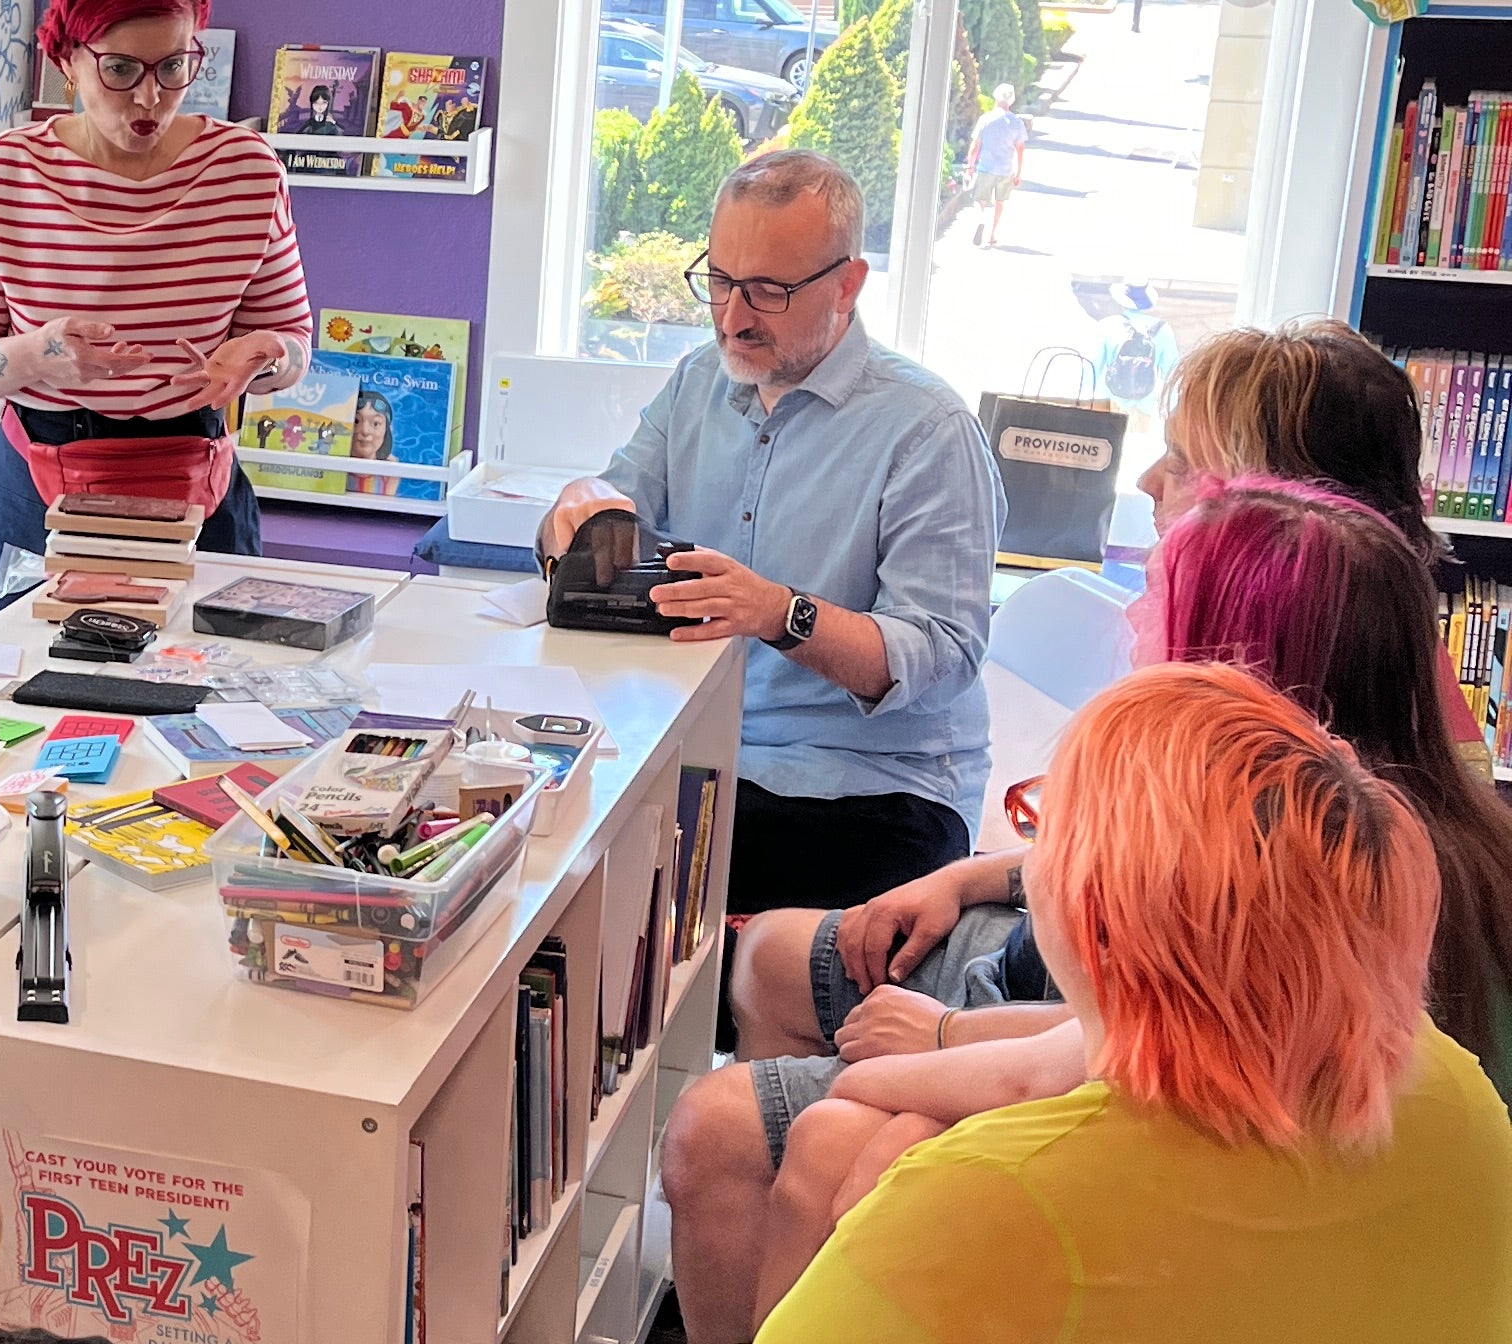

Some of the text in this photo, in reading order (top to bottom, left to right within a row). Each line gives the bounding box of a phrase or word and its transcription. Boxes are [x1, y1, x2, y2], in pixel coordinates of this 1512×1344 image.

[300, 64, 358, 81] WEDNESDAY
[408, 66, 466, 85] SHAZAM!
[293, 155, 305, 168] AM
[307, 154, 346, 169] WEDNESDAY
[394, 162, 429, 174] HEROES
[373, 373, 399, 387] Can
[403, 374, 438, 391] Swim
[1014, 435, 1100, 457] PROVISIONS
[305, 792, 362, 802] Pencils
[310, 785, 346, 793] Color
[298, 803, 319, 812] 24
[25, 1150, 244, 1196] CAST YOUR VOTE FOR THE
[39, 1170, 82, 1187] FIRST
[89, 1178, 128, 1195] TEEN
[23, 1193, 193, 1324] PREZ
